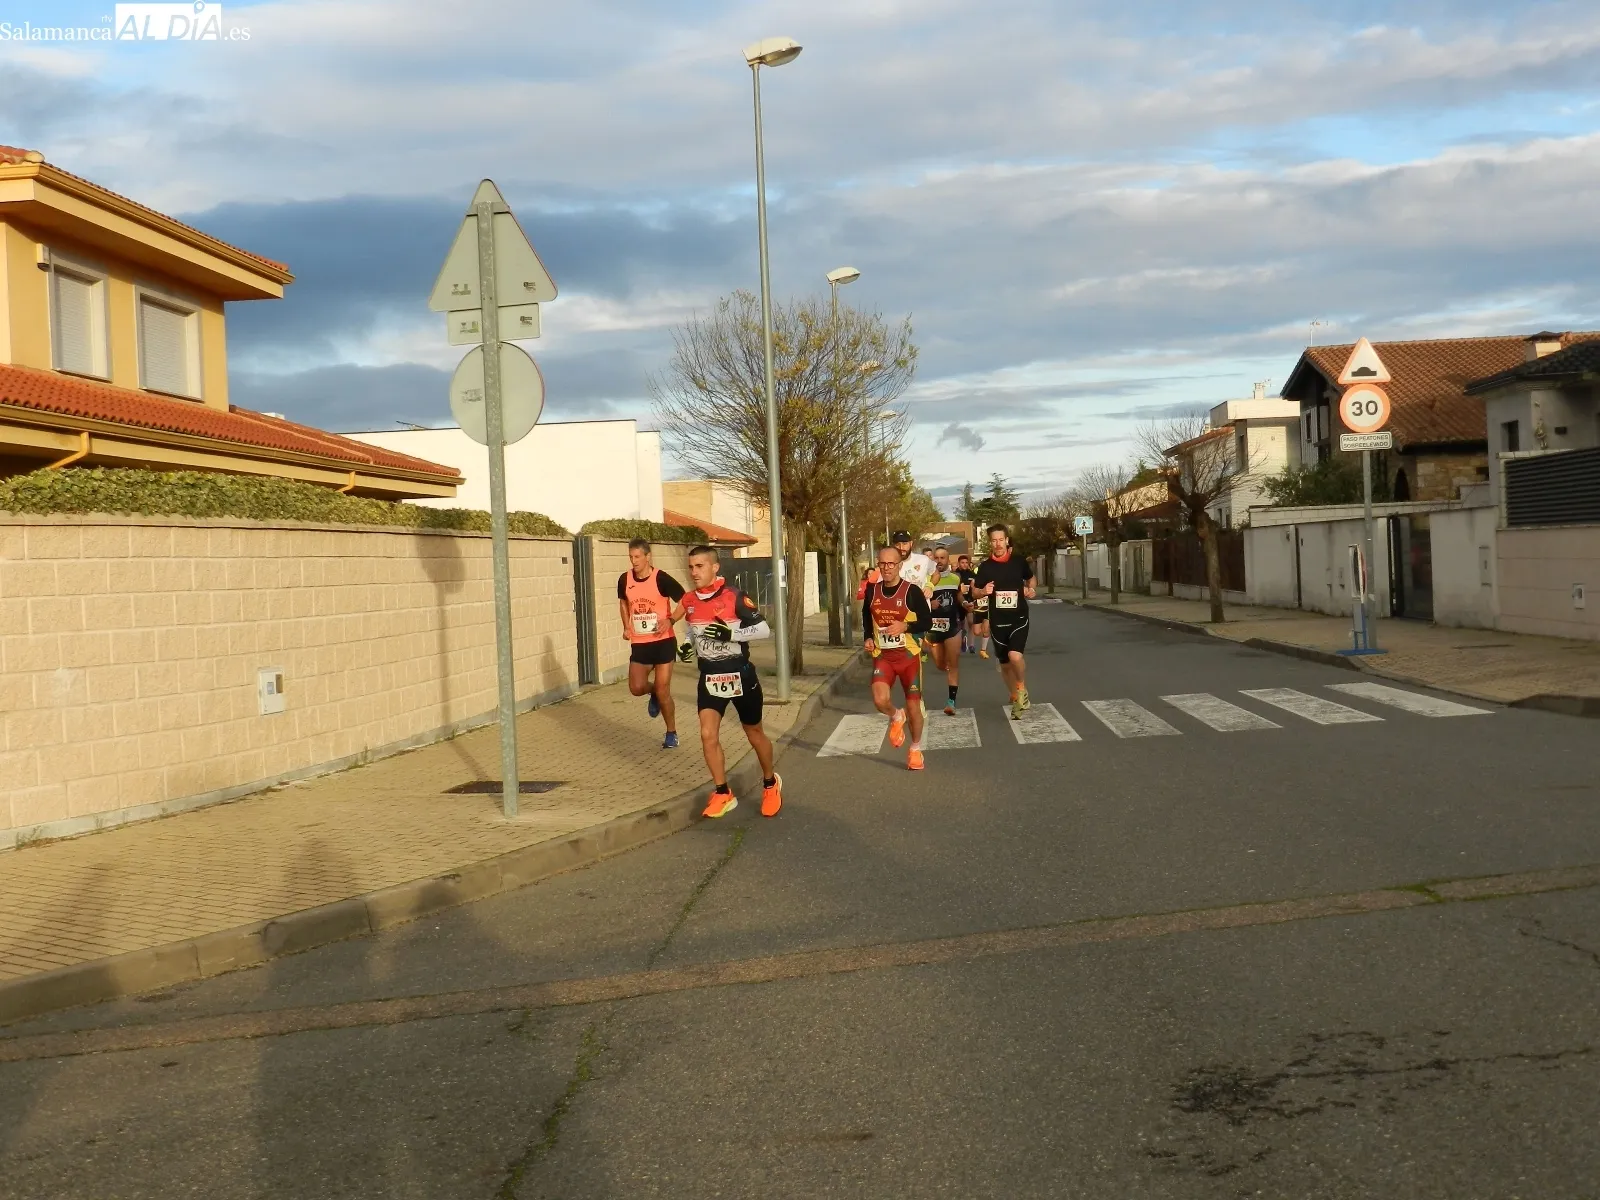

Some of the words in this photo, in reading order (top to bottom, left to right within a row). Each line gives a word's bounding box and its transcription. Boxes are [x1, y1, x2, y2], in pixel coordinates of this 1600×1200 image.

[1351, 400, 1378, 417] 30
[1001, 596, 1012, 605] 20
[641, 620, 648, 629] 8
[932, 622, 947, 630] 243
[713, 681, 735, 692] 161
